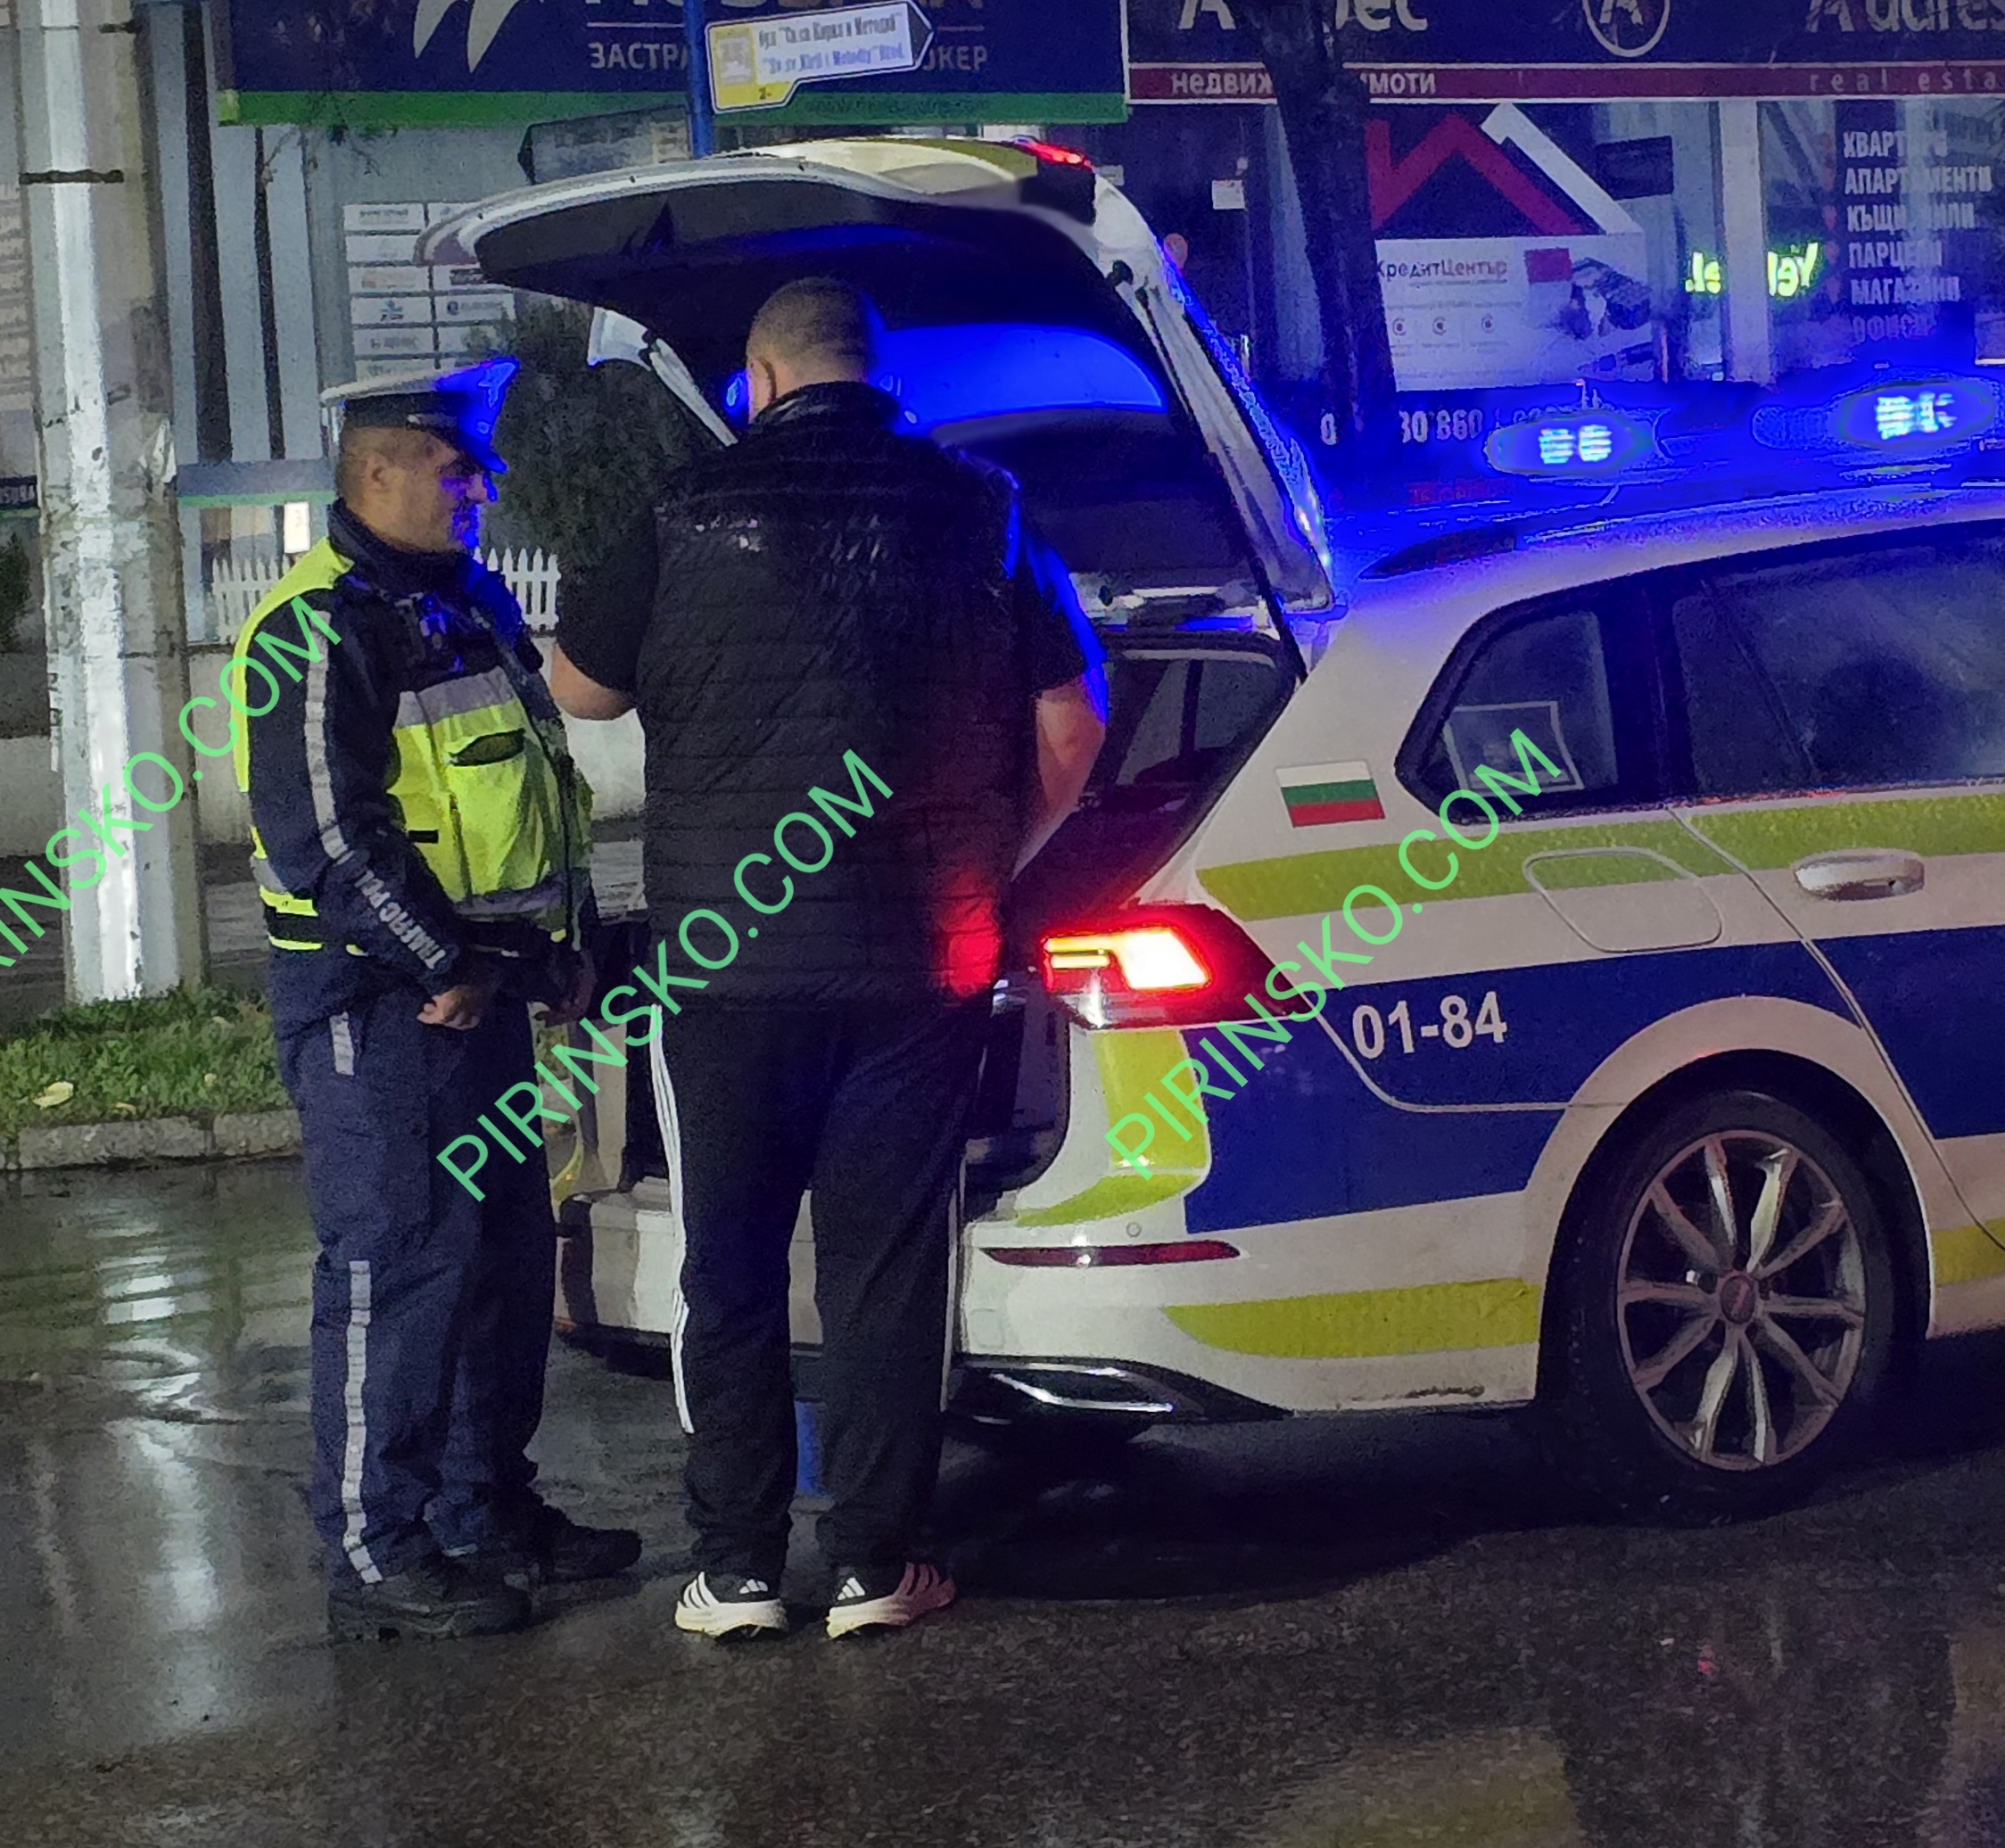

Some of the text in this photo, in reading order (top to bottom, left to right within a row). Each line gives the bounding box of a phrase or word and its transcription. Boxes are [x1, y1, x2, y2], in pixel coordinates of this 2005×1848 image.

[1810, 67, 2000, 92] real esta
[1352, 990, 1507, 1060] 01-84
